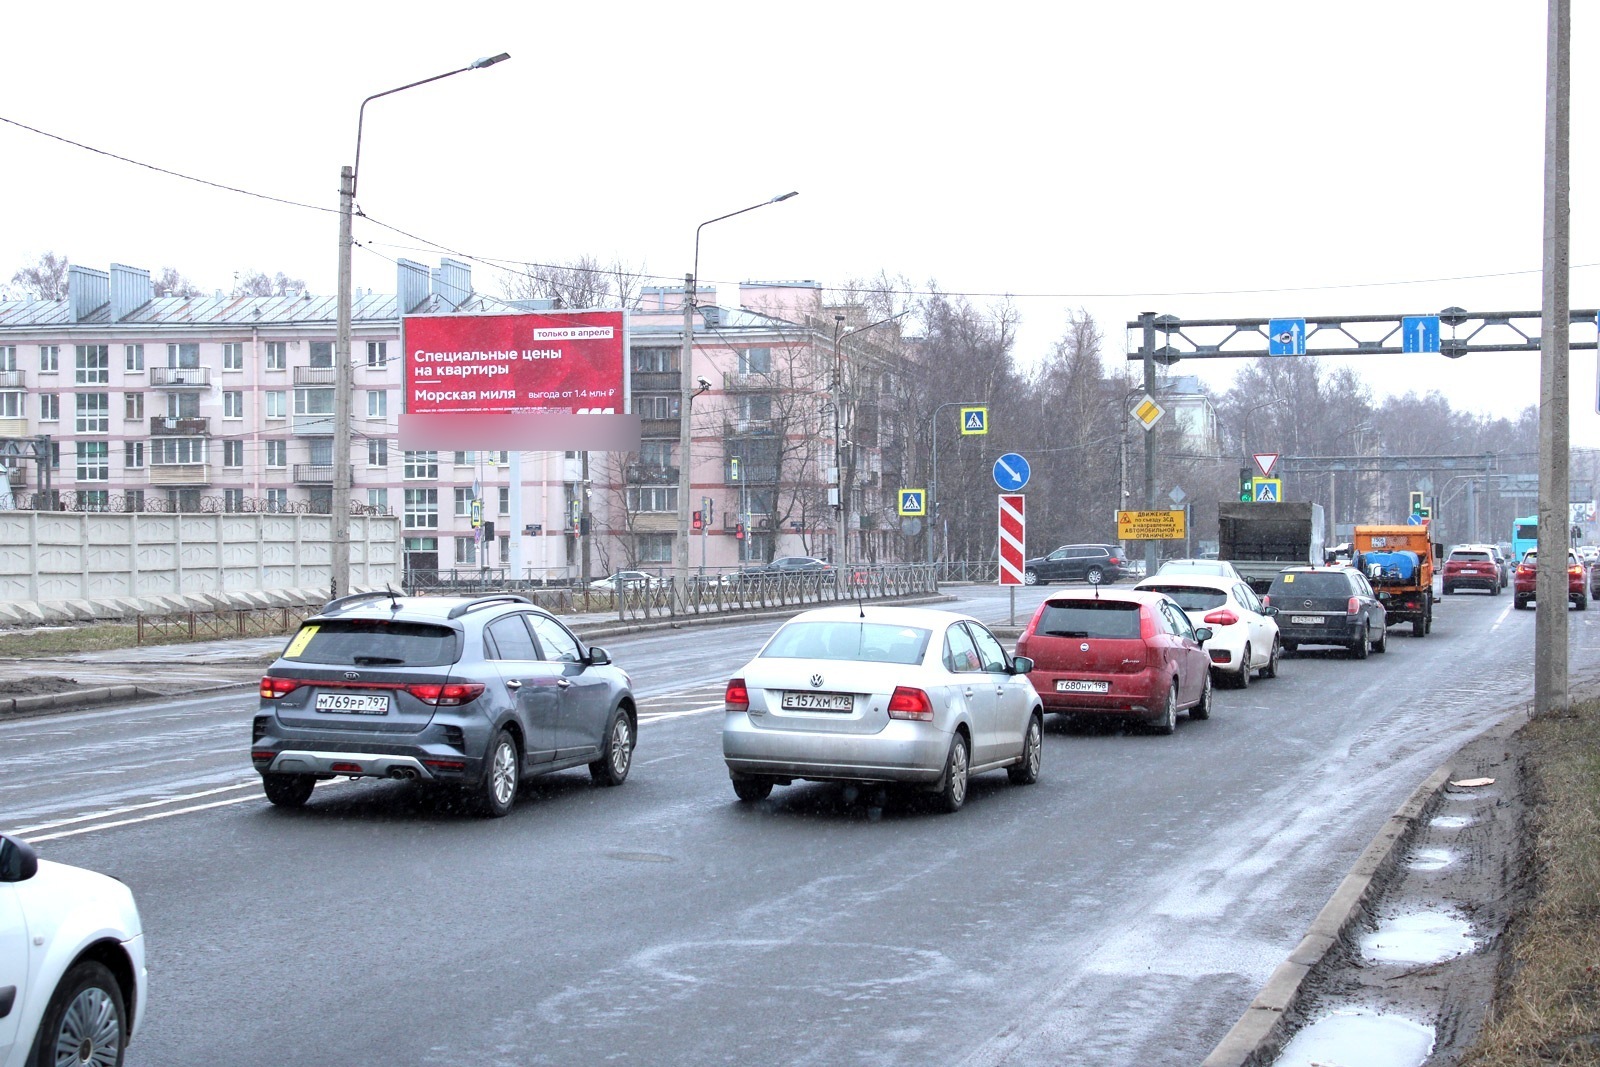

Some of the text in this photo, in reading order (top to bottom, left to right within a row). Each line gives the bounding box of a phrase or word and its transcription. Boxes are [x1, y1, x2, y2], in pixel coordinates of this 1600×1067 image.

[537, 330, 568, 338] только
[577, 329, 610, 337] апреле
[414, 349, 562, 363] Специальные цены
[414, 364, 509, 378] на квартиры
[415, 389, 516, 403] Морская миля
[528, 391, 560, 399] выгода
[562, 390, 572, 398] от
[589, 390, 606, 398] млн
